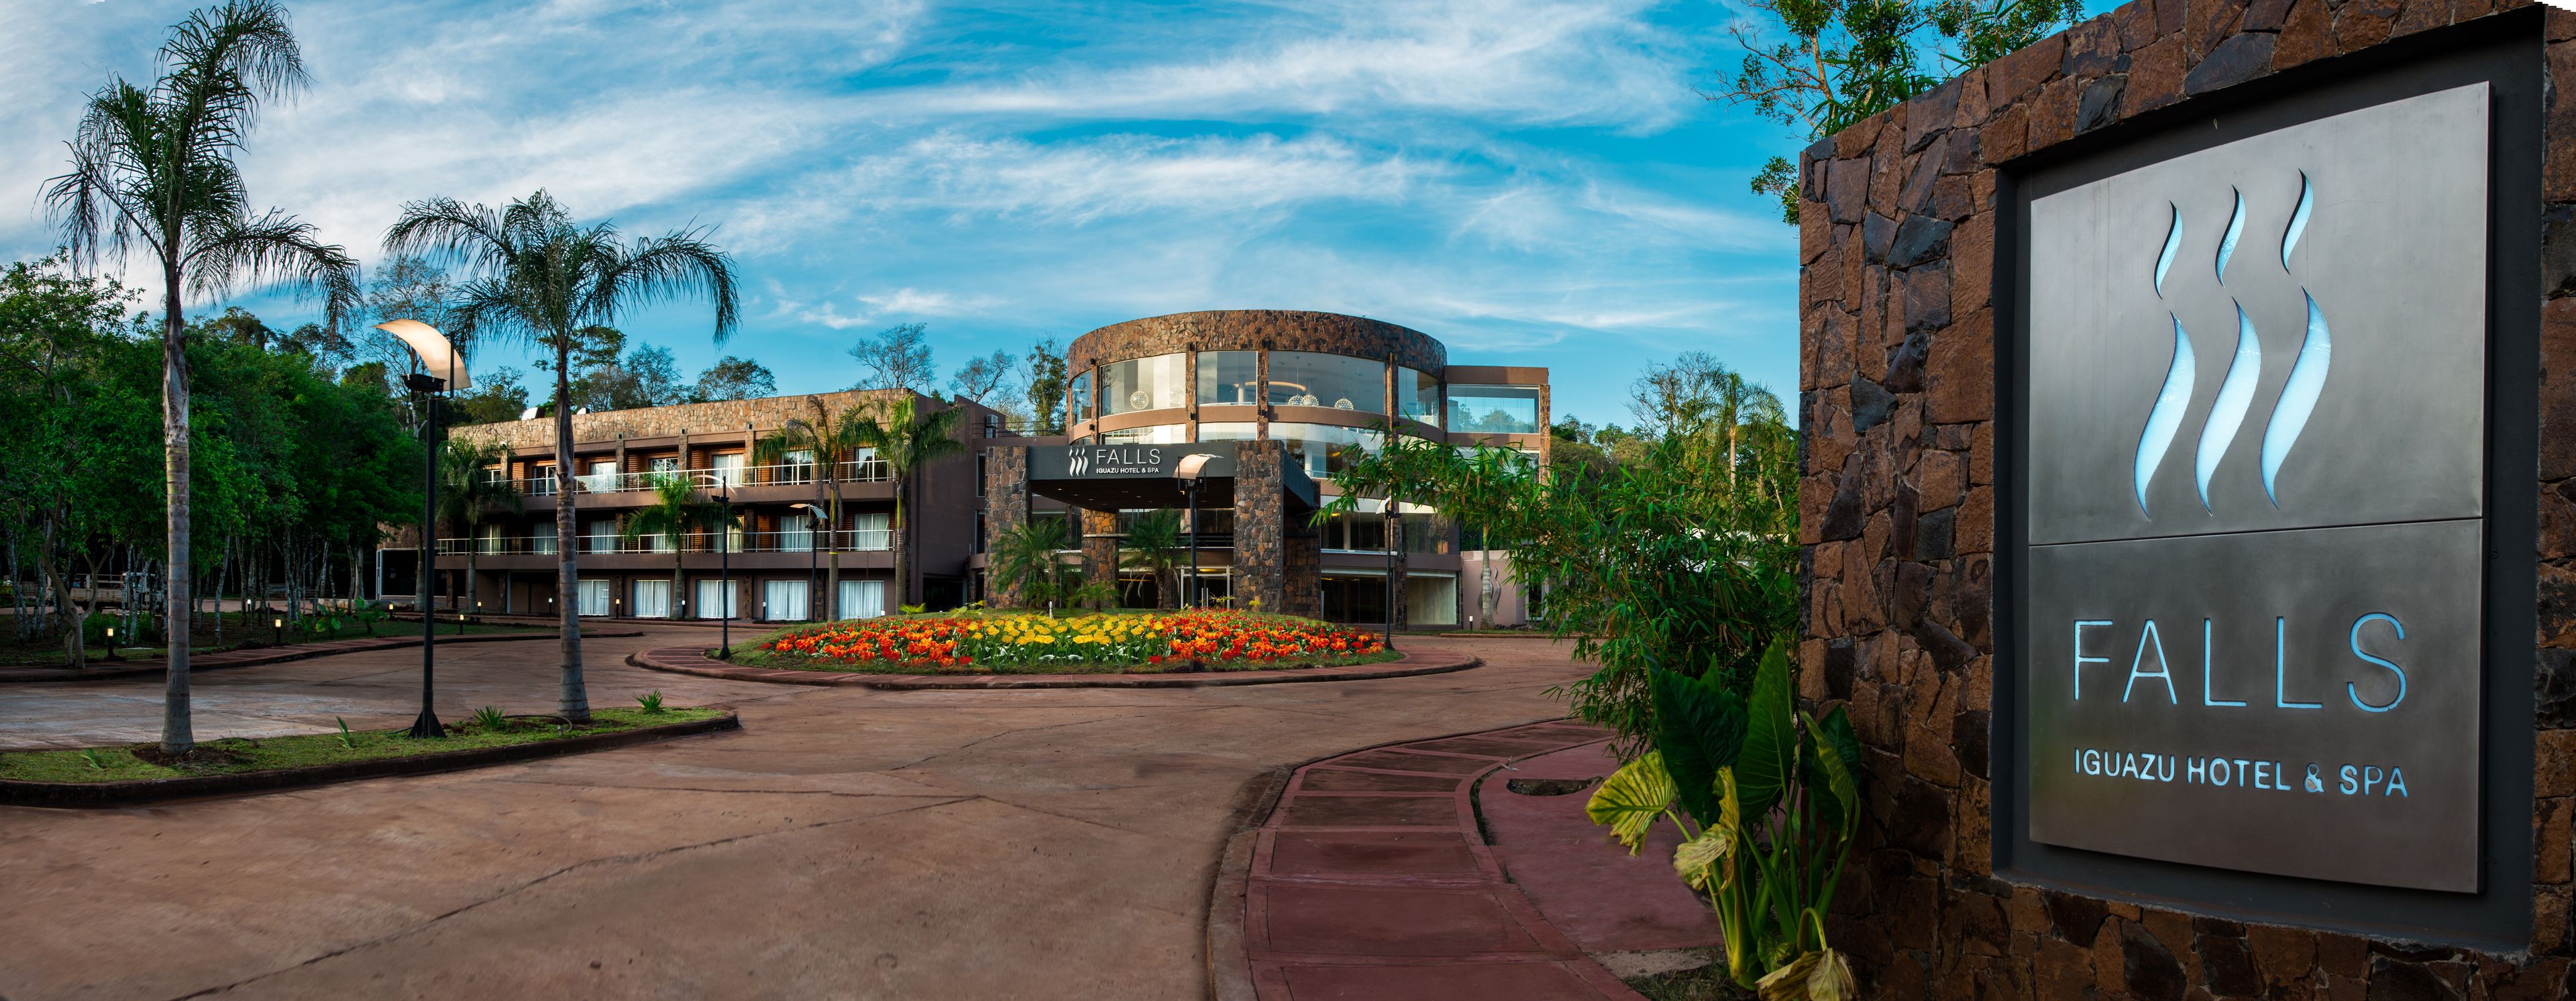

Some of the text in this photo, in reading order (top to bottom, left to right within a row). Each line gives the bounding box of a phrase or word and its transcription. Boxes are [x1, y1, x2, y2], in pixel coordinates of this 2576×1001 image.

[1096, 448, 1161, 465] FALLS
[2073, 612, 2408, 713] FALLS
[2074, 747, 2409, 798] IGUAZU HOTEL & SPA
